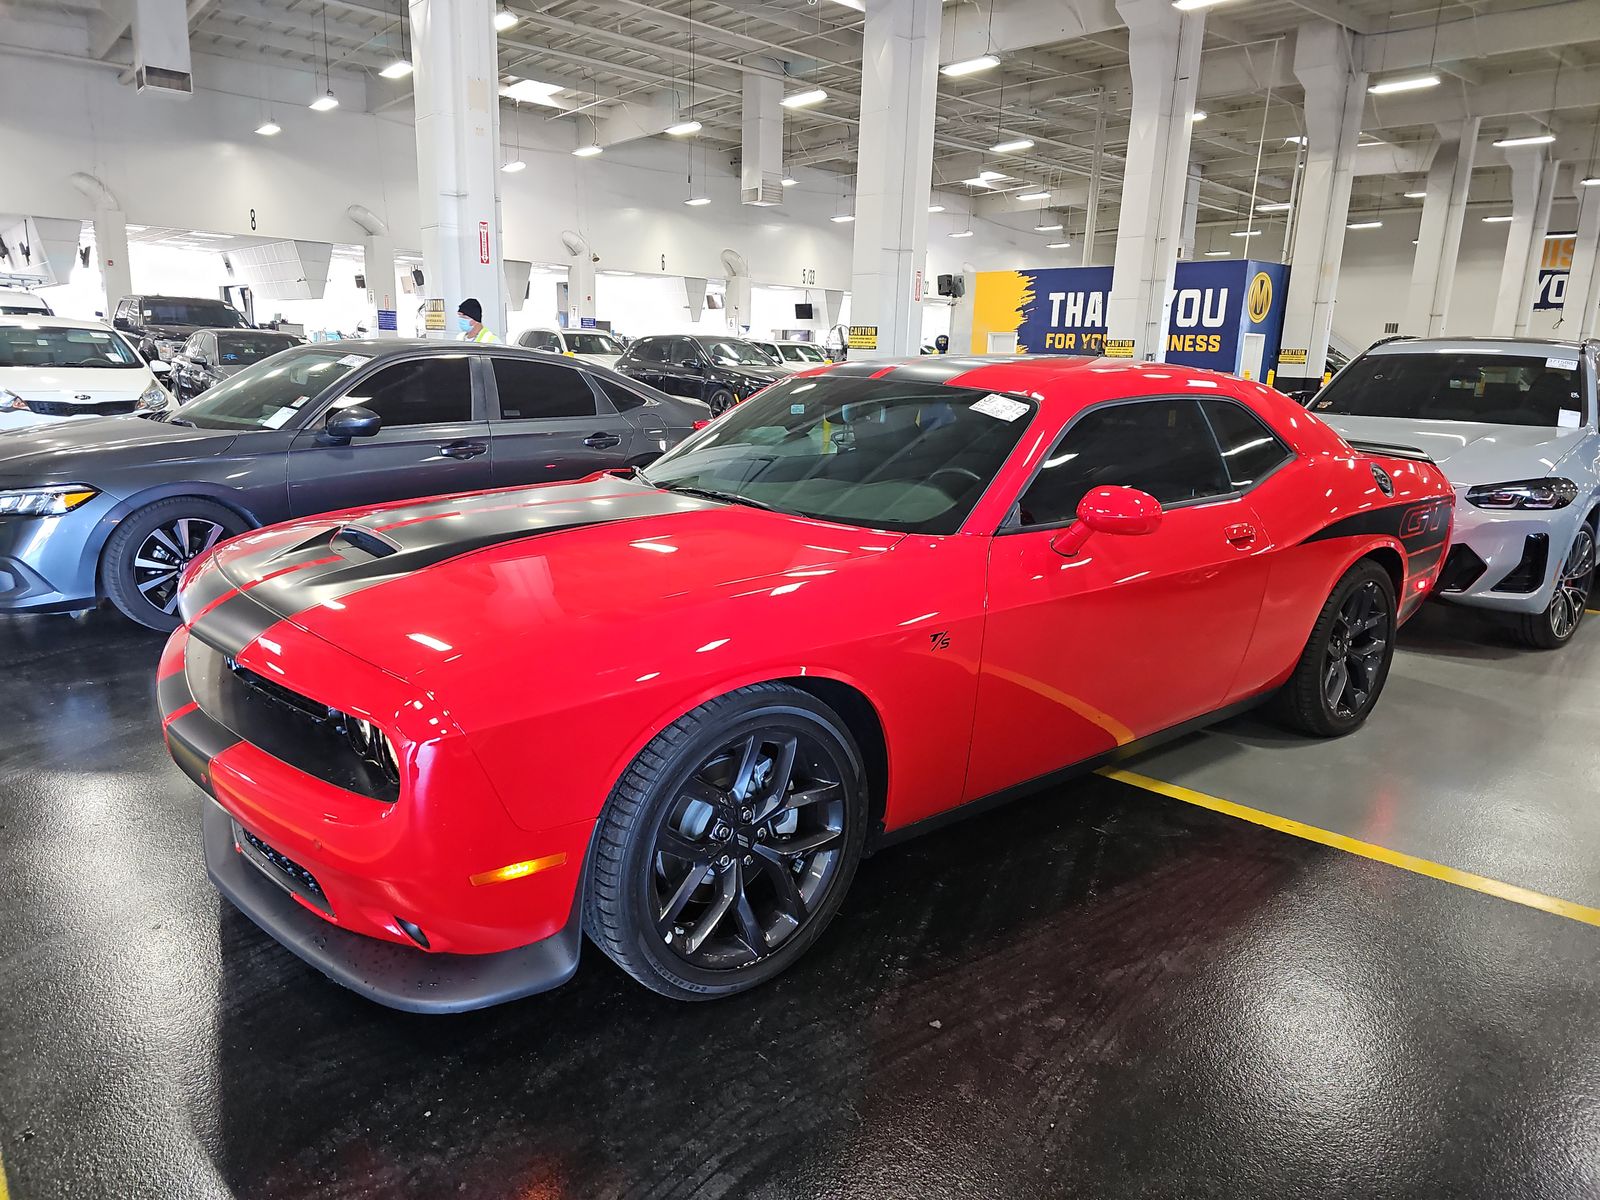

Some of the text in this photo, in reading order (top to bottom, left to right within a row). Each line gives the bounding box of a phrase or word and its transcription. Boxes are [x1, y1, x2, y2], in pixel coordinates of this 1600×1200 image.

[250, 208, 256, 231] 8
[1534, 274, 1569, 303] YO
[1049, 291, 1112, 327] THA
[850, 327, 876, 335] CAUTION
[1045, 333, 1076, 349] FOR
[1166, 335, 1221, 351] INESS
